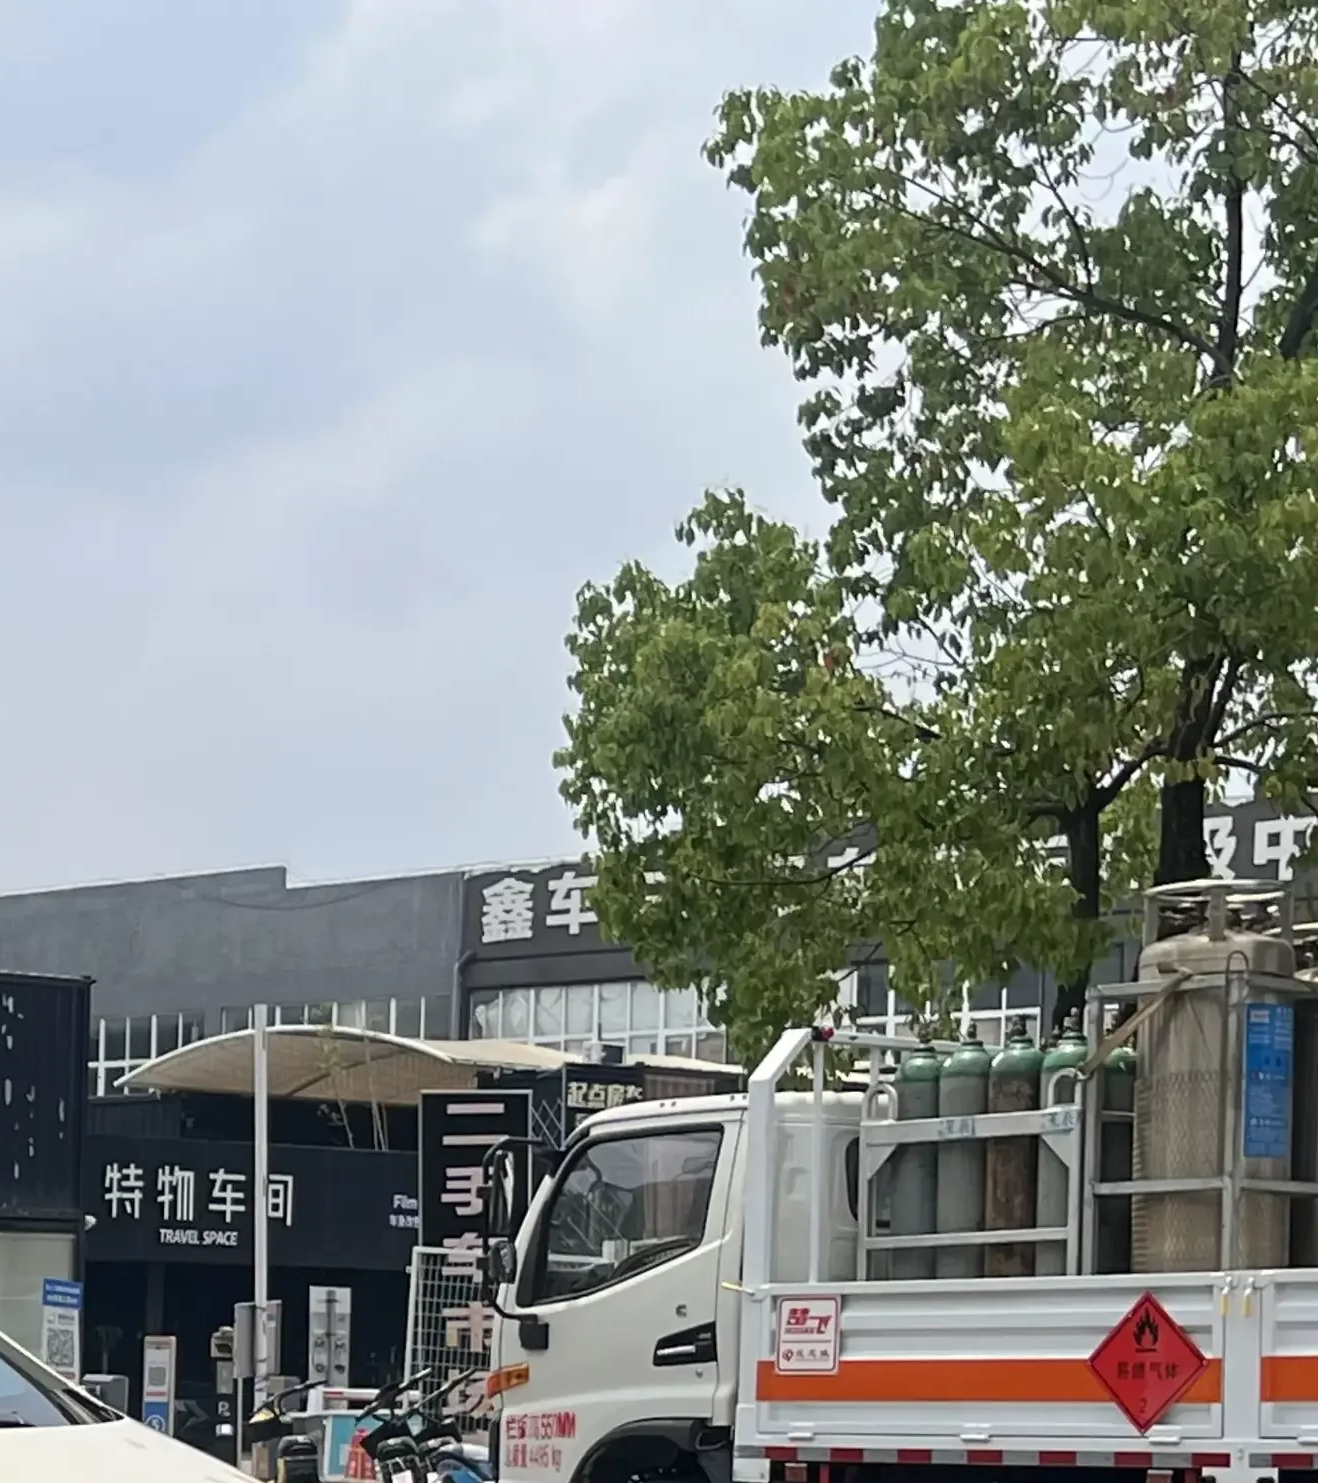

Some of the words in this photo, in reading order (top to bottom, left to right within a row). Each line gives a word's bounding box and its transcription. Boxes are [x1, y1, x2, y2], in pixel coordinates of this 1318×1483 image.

[104, 1162, 294, 1227] 特物车间
[159, 1228, 200, 1244] TRAVEL
[202, 1231, 238, 1245] SPACE
[1117, 1362, 1178, 1379] 易燃气体
[1139, 1399, 1148, 1413] 2
